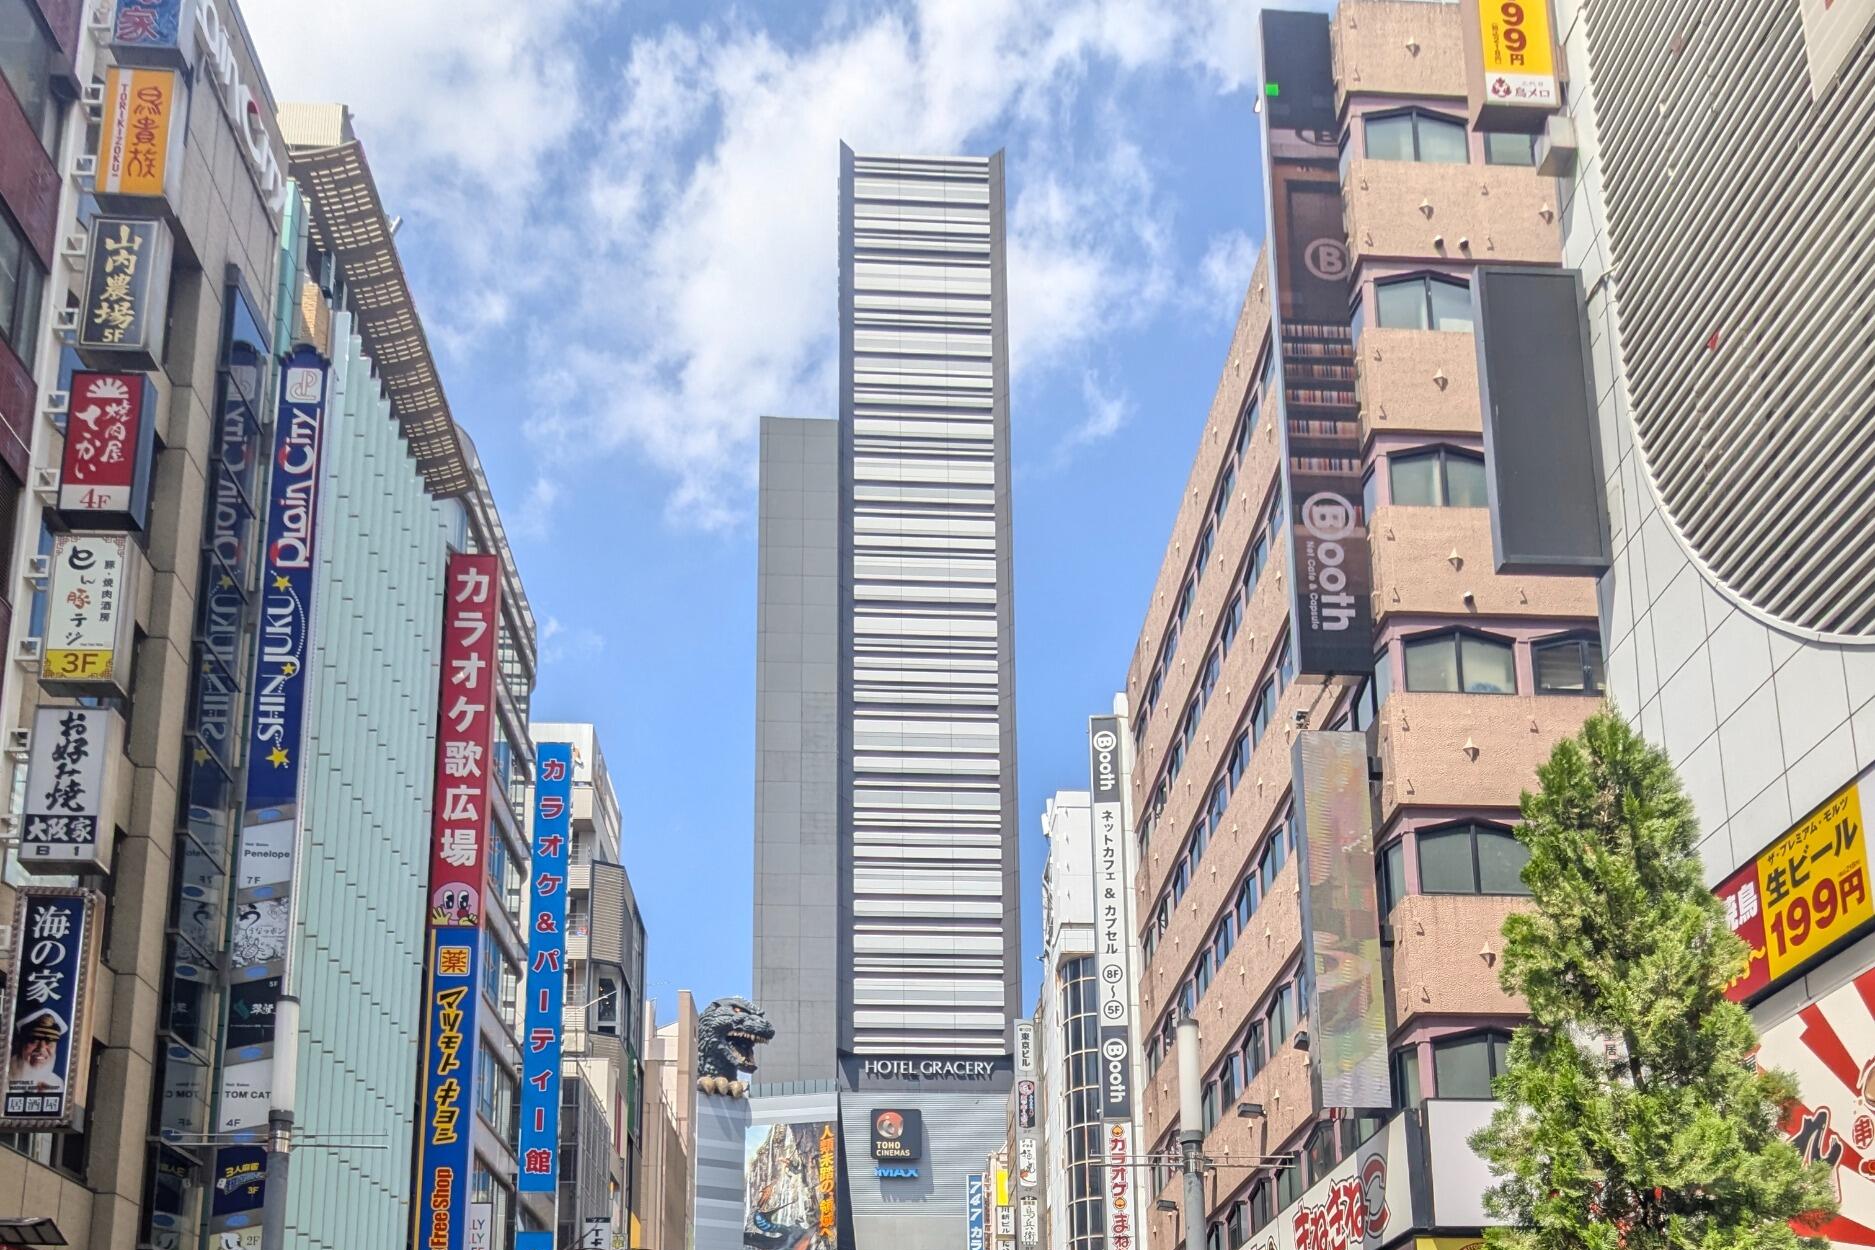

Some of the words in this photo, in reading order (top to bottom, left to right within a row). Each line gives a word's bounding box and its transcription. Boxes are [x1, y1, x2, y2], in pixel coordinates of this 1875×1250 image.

[116, 0, 160, 41] 家
[1501, 0, 1527, 66] 99円
[94, 224, 143, 329] 山内農場
[103, 328, 124, 343] 5F
[100, 399, 133, 464] 焼肉屋
[79, 488, 111, 509] 4F
[1302, 491, 1357, 632] Booth
[61, 652, 99, 674] 3F
[257, 595, 301, 742] SHINJUKU
[440, 566, 490, 868] カラオケ歌広場
[45, 710, 89, 812] お好み焼
[26, 818, 95, 842] 大阪家
[1101, 809, 1115, 881] ネットカフェ
[244, 849, 290, 859] Penelope
[1765, 816, 1858, 909] 生ビール
[247, 876, 261, 885] 7F
[1104, 886, 1116, 900] &
[1103, 904, 1119, 954] カプセル
[1770, 867, 1866, 958] 199円
[27, 905, 72, 1004] 海の家
[441, 949, 469, 973] 薬
[1106, 969, 1120, 980] 8F
[1107, 1005, 1121, 1015] 5F
[432, 985, 468, 1145] マツモトキヨシ
[864, 1060, 918, 1074] HOTEL
[920, 1060, 995, 1075] GRACERY
[225, 1090, 249, 1099] TOM
[250, 1090, 272, 1099] CAT
[225, 1118, 241, 1127] 4F
[876, 1141, 901, 1149] TOHO
[876, 1149, 911, 1157] CINEMAS
[873, 1166, 919, 1178] IMAX
[1110, 1137, 1129, 1196] カラオケ
[432, 1166, 454, 1213] Shop
[431, 1211, 451, 1248] Free
